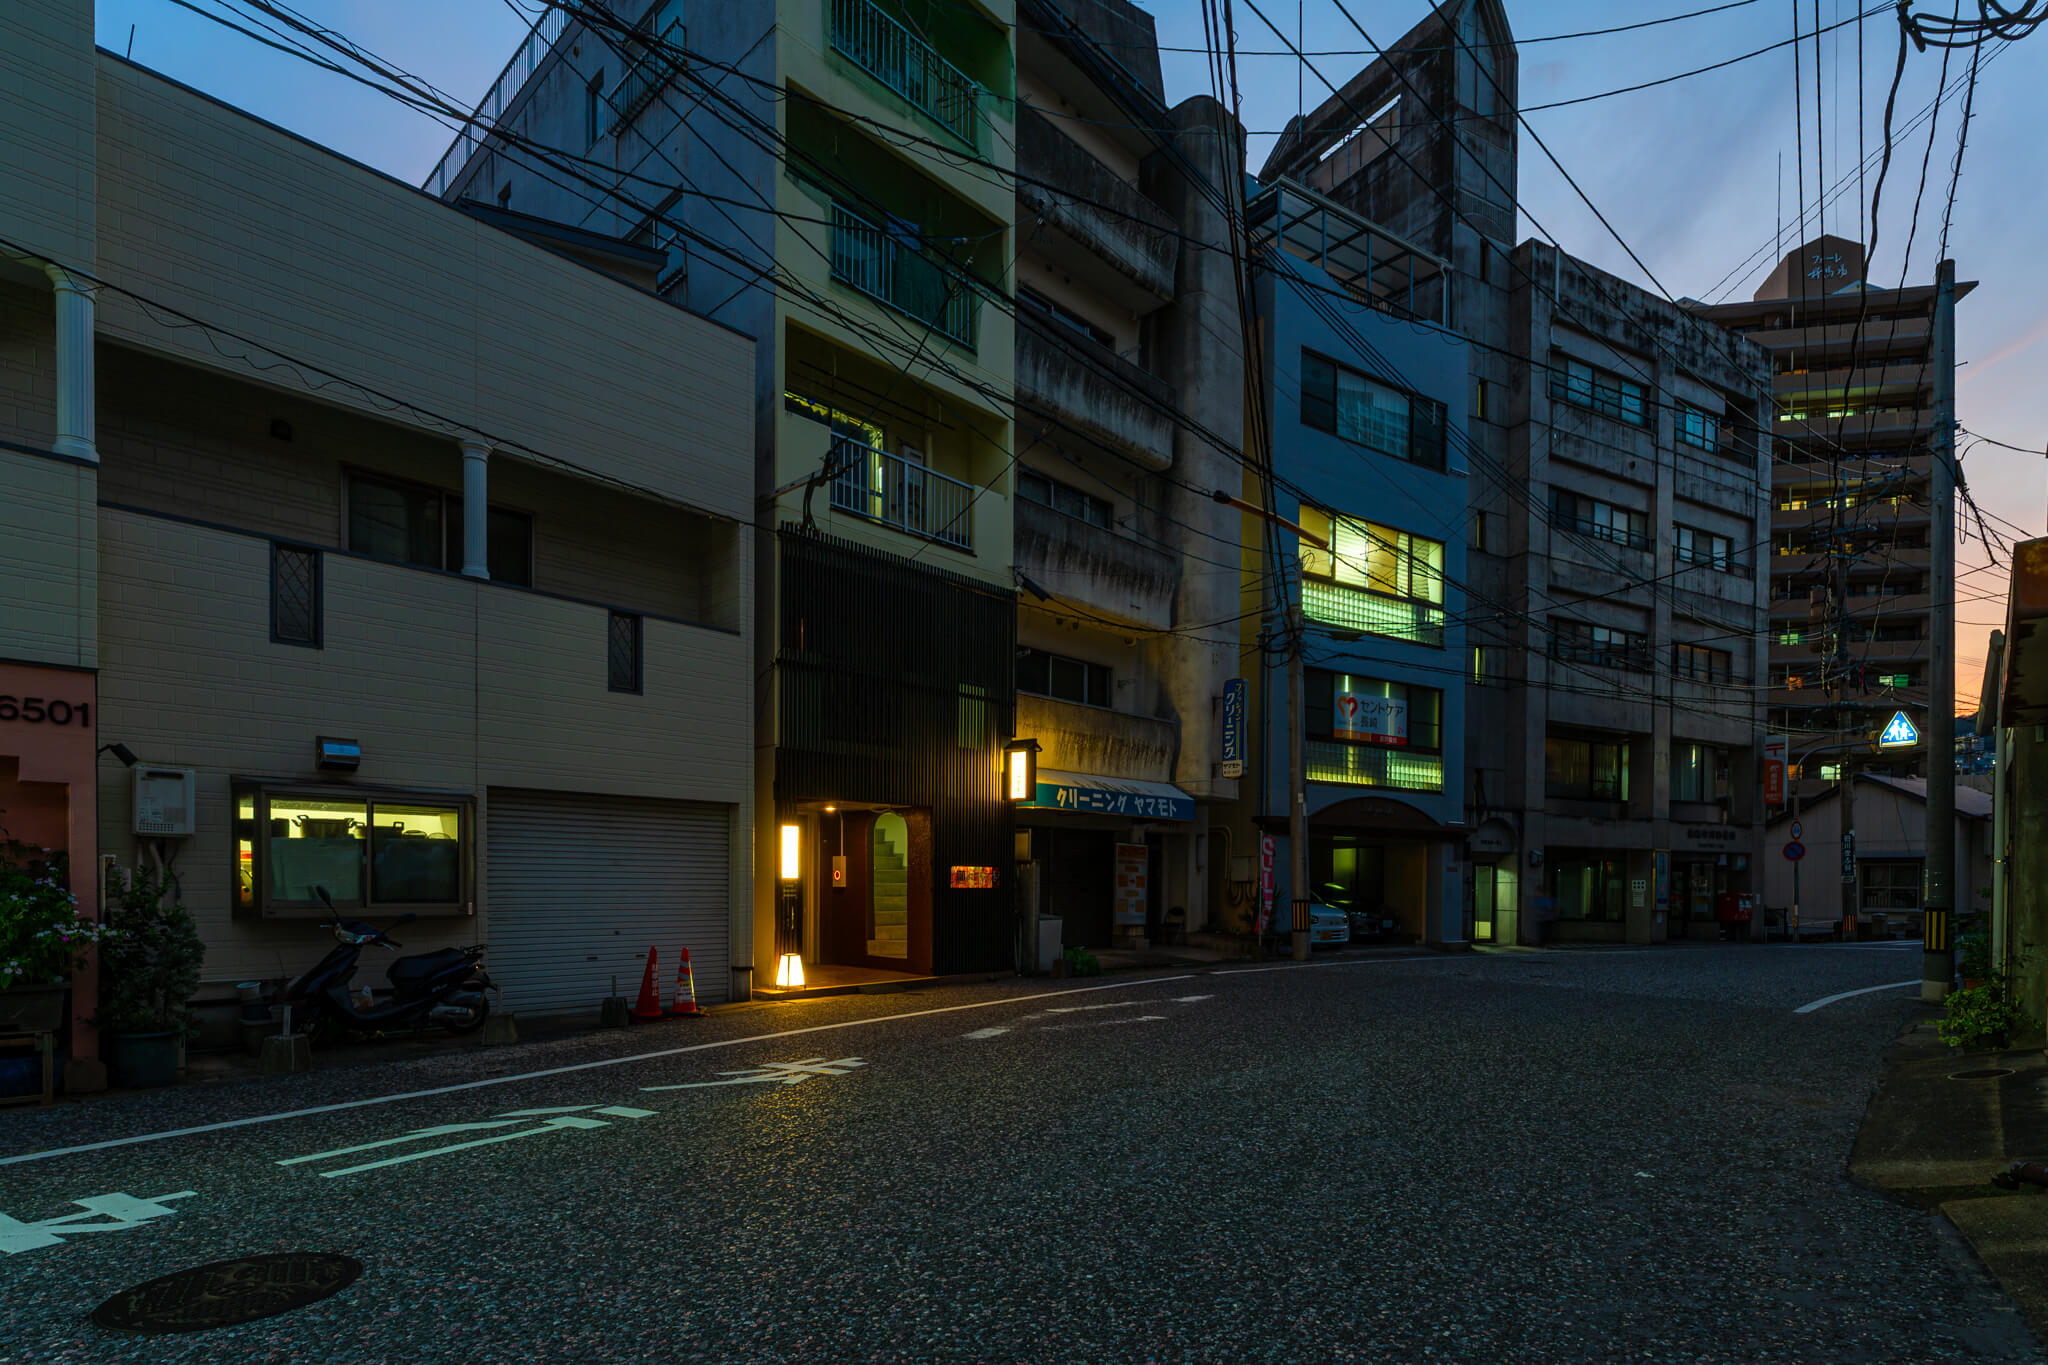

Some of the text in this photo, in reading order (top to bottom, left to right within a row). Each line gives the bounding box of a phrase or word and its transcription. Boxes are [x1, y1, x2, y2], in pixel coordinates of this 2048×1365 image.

[1360, 700, 1404, 718] セントケア
[1224, 692, 1236, 759] クリーニング
[1056, 787, 1177, 818] クリーニング ヤマモト
